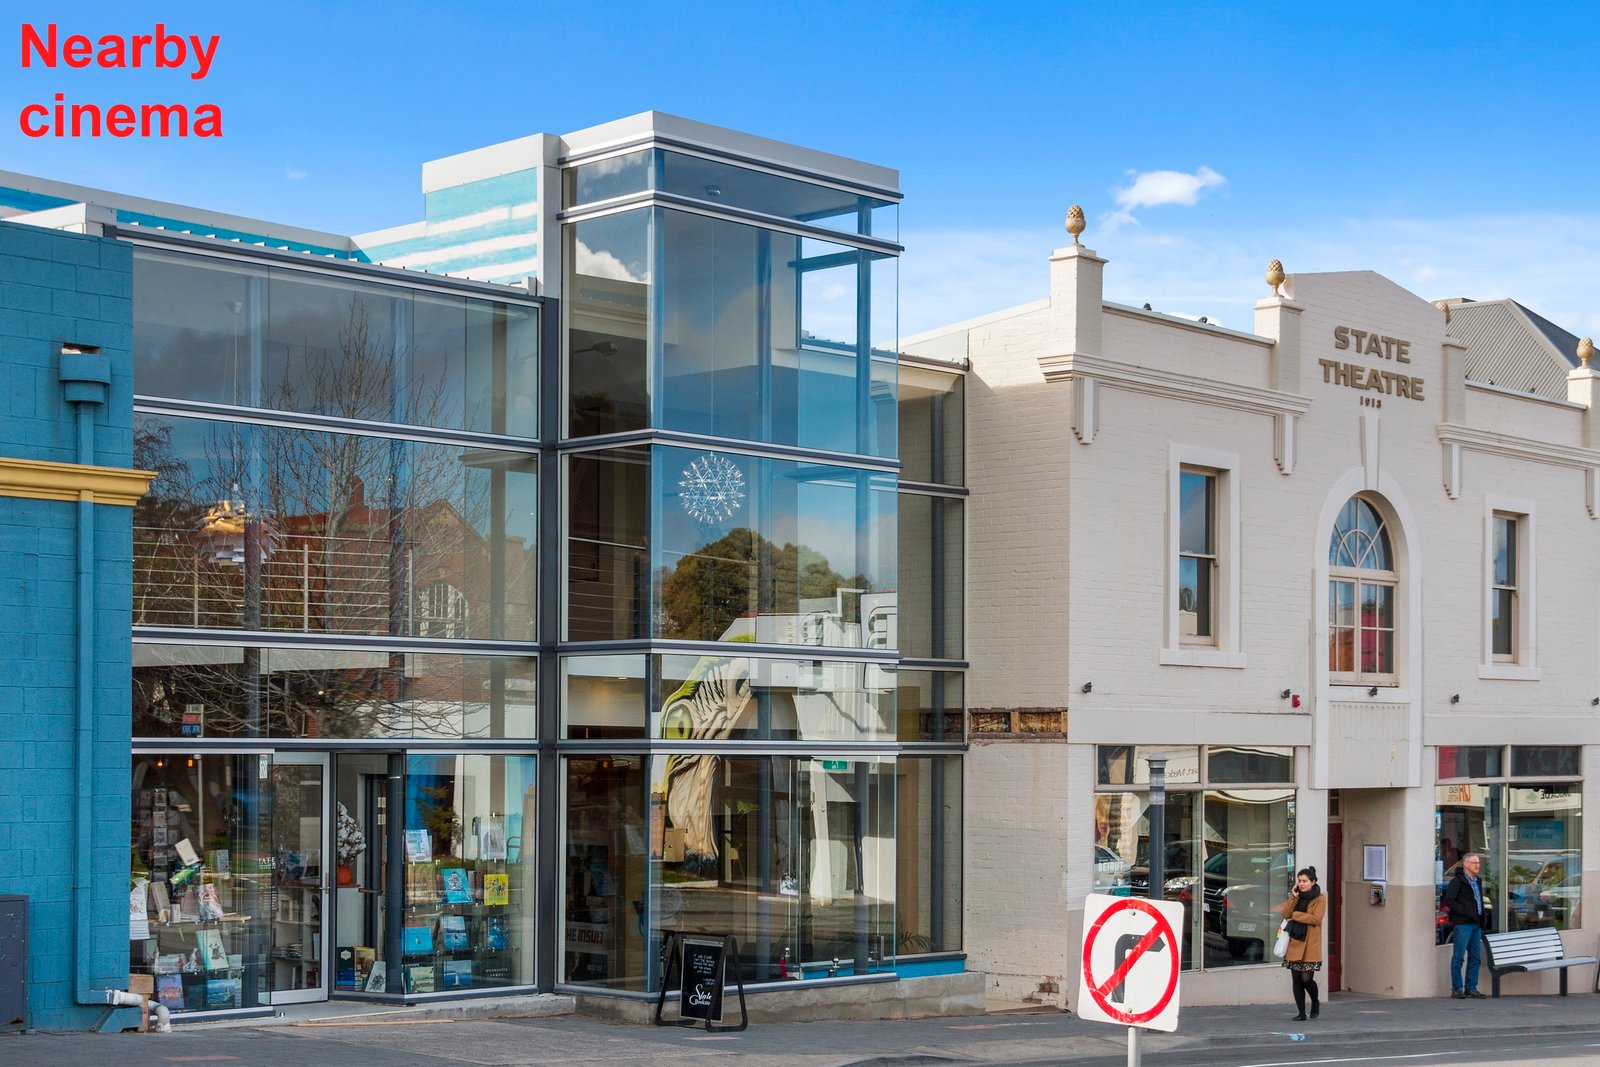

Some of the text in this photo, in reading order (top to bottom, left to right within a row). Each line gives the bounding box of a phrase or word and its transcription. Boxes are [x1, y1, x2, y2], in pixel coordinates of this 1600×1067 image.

[1334, 325, 1411, 364] STATE
[1318, 358, 1425, 401] THEATRE
[1359, 396, 1382, 409] 1913
[1098, 861, 1125, 872] BEIRUT
[565, 927, 577, 942] HE
